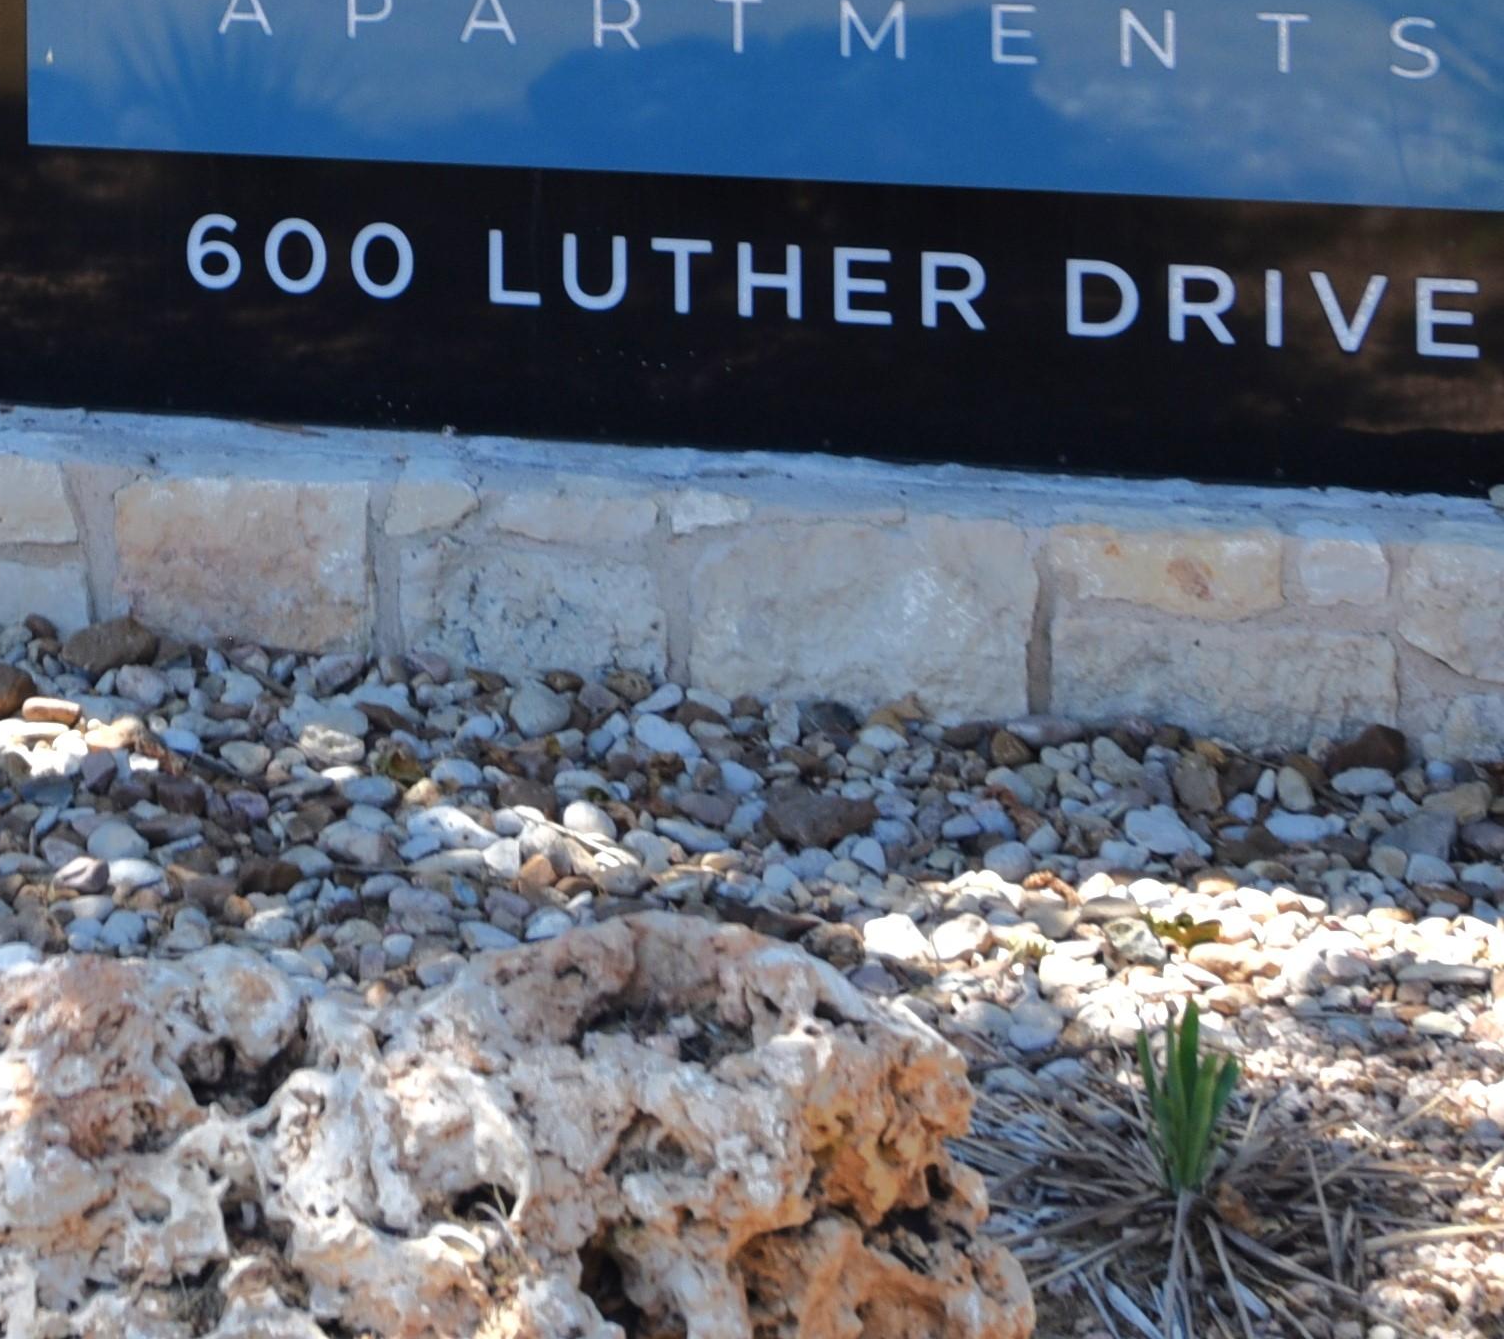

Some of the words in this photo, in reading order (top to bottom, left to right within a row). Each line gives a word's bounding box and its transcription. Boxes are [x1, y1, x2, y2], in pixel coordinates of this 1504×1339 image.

[187, 214, 414, 298] 600
[488, 229, 986, 330] LUTHER
[1066, 258, 1480, 359] DRIVE
